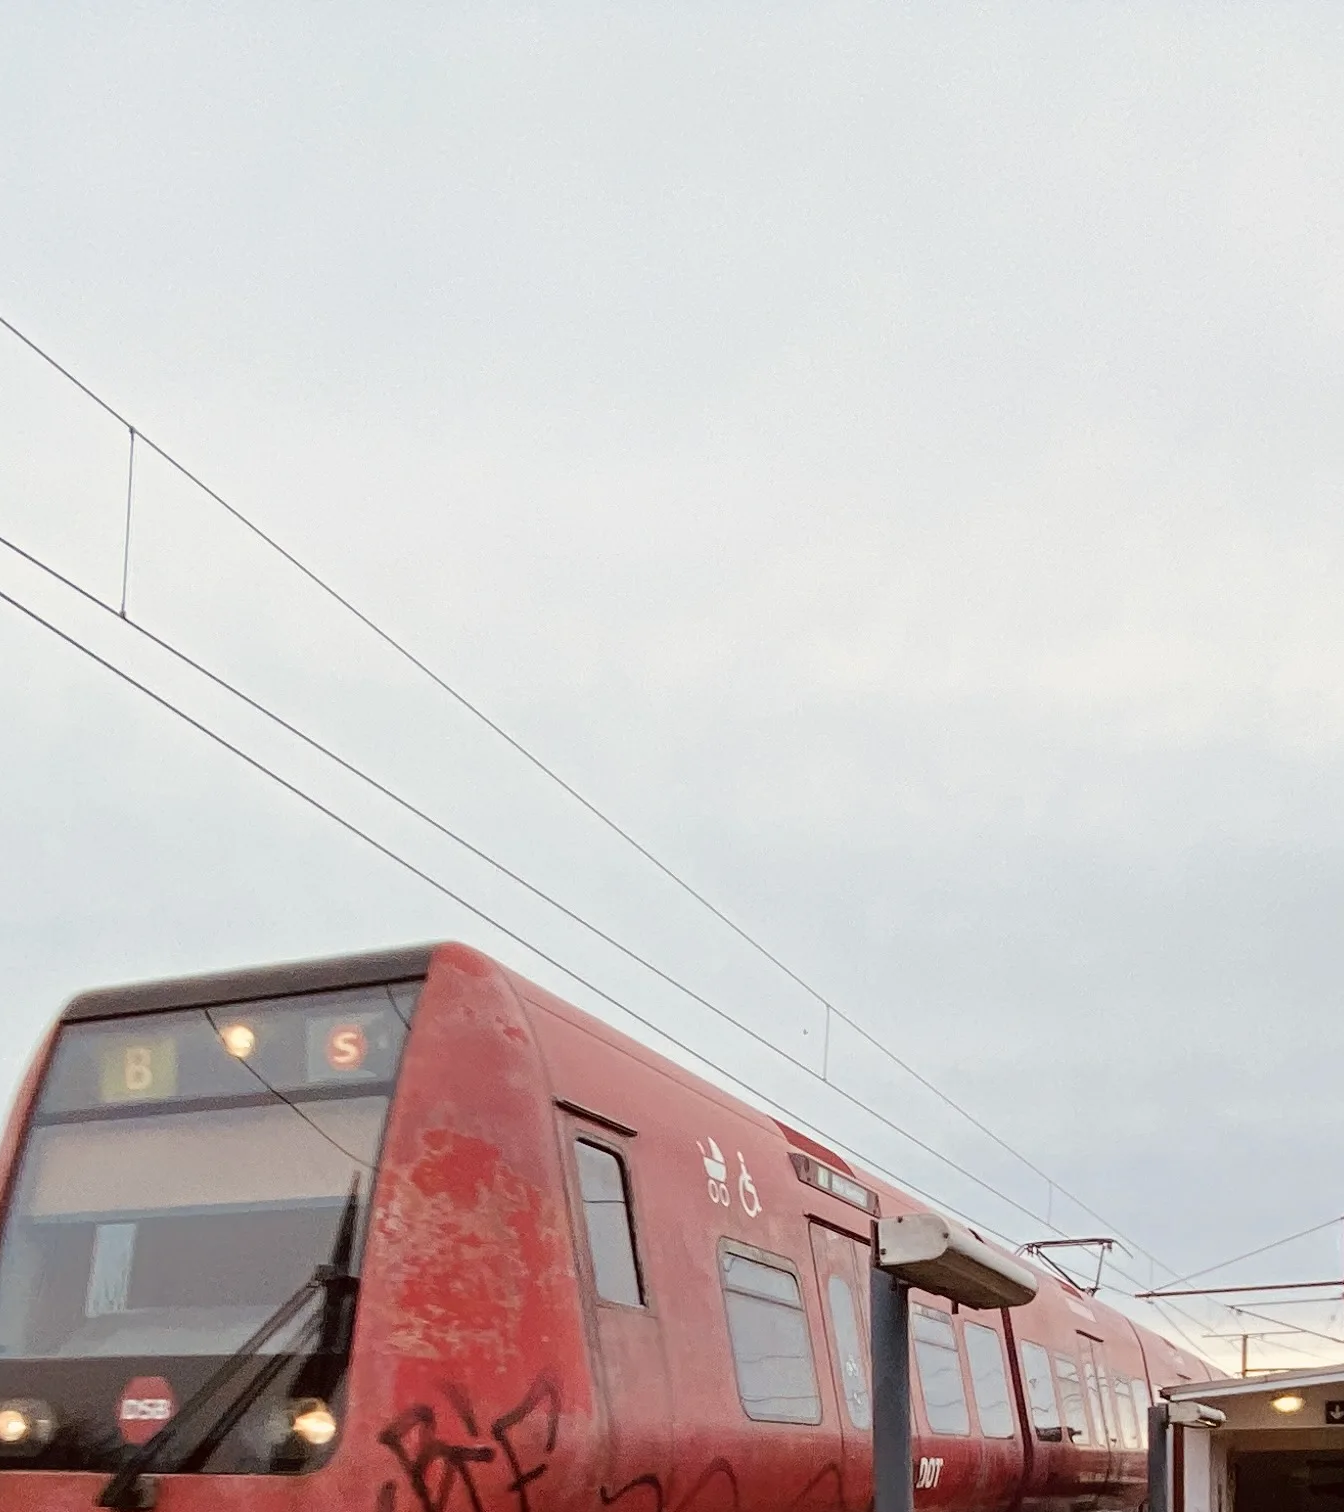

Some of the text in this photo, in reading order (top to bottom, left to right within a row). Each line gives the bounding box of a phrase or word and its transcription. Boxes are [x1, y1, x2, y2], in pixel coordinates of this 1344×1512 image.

[331, 1031, 360, 1065] S
[124, 1047, 153, 1091] B
[119, 1398, 171, 1420] DSB
[916, 1456, 944, 1489] DOT
